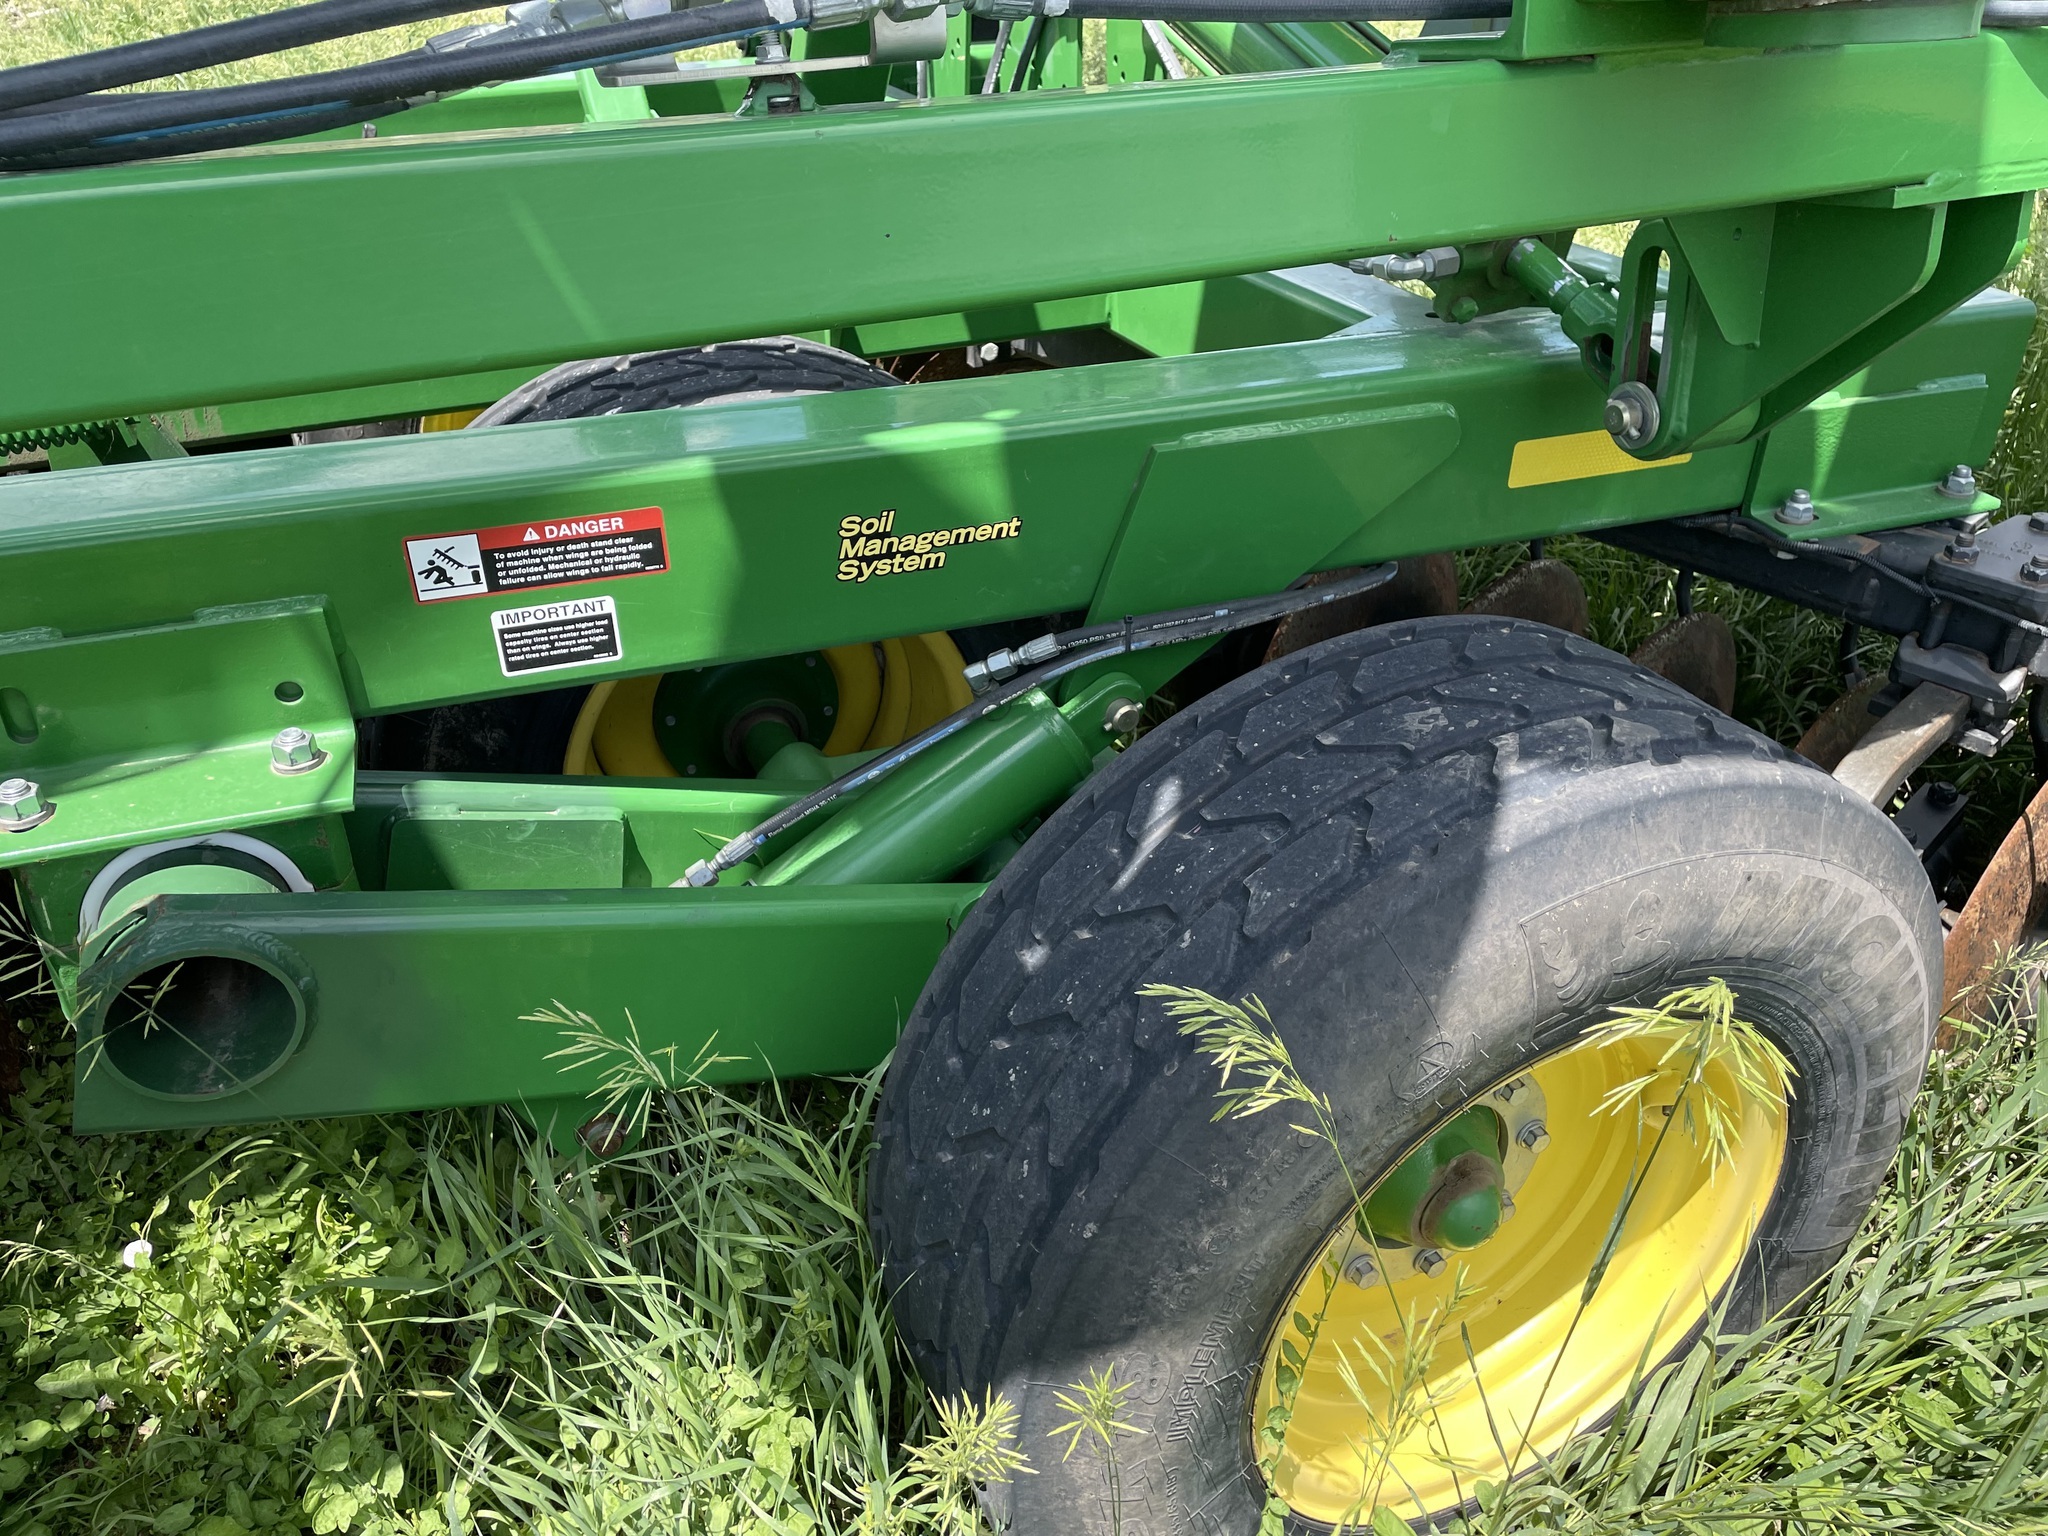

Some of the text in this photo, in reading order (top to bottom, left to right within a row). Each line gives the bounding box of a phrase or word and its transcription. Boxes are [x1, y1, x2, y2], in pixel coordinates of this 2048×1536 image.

[545, 516, 624, 539] DANGER
[838, 509, 896, 538] Soil
[507, 550, 529, 558] avoid
[531, 547, 554, 555] injury
[567, 542, 589, 550] death
[591, 539, 612, 547] stand
[838, 516, 1022, 559] Management
[507, 558, 540, 567] machine
[565, 551, 589, 559] wings
[605, 546, 627, 554] being
[628, 542, 652, 551] folded
[509, 565, 546, 575] unfolded.
[548, 559, 592, 570] Mechanical
[605, 553, 640, 563] hydraulic
[836, 551, 946, 583] System
[499, 577, 525, 585] failure
[566, 568, 589, 576] wings
[615, 561, 644, 570] rapidly.
[500, 599, 606, 626] IMPORTANT
[1689, 870, 1926, 1229] MICHELIN
[1165, 1251, 1265, 1443] IMPLEMENT
